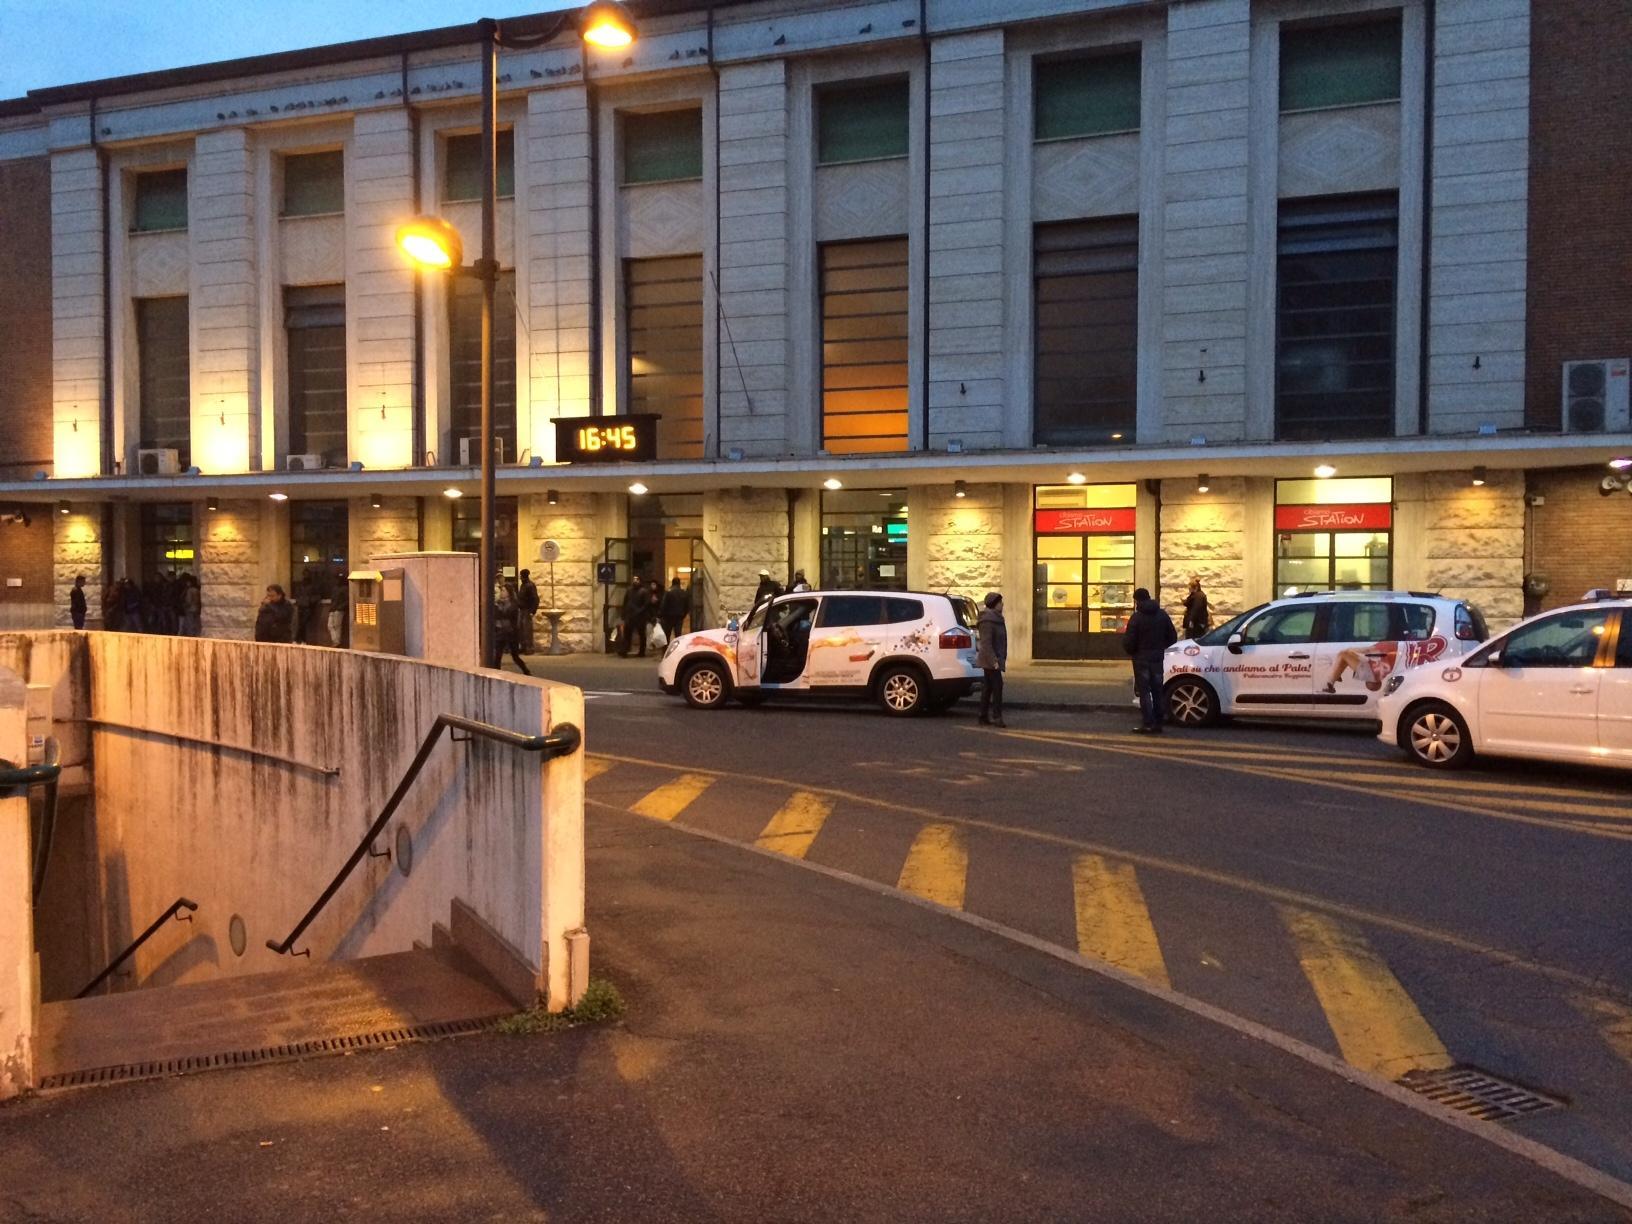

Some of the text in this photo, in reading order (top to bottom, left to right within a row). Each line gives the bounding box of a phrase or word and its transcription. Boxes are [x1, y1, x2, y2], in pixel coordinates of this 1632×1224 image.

[579, 426, 636, 450] 16:45
[1204, 664, 1220, 673] che
[1223, 664, 1266, 673] andiamo
[1269, 664, 1279, 672] al
